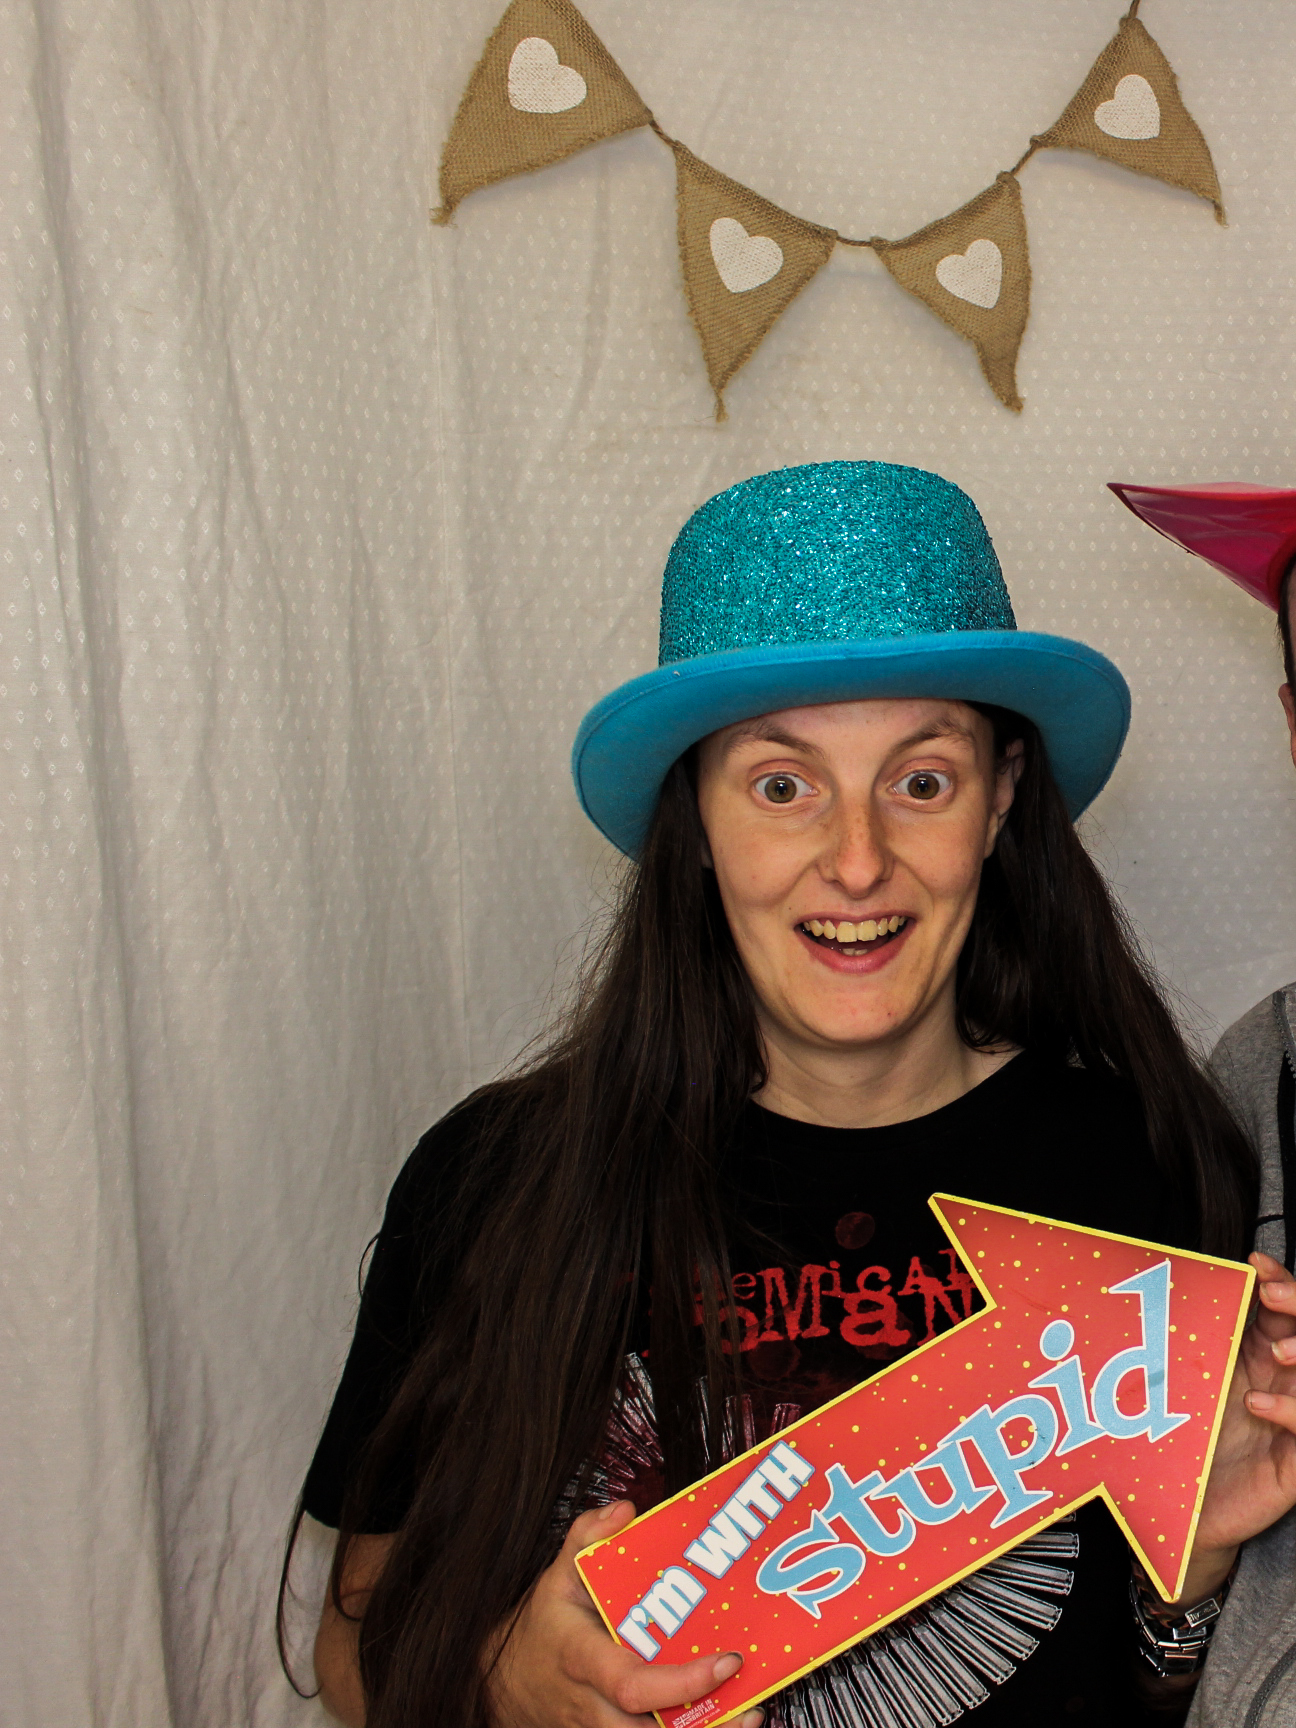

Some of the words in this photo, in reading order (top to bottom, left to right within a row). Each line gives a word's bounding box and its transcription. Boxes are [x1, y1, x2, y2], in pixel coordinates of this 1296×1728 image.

[756, 1260, 1191, 1620] stupid
[682, 1440, 816, 1580] WITH
[689, 1702, 706, 1715] MADE
[705, 1698, 713, 1706] IN
[691, 1703, 715, 1720] BRITAIN
